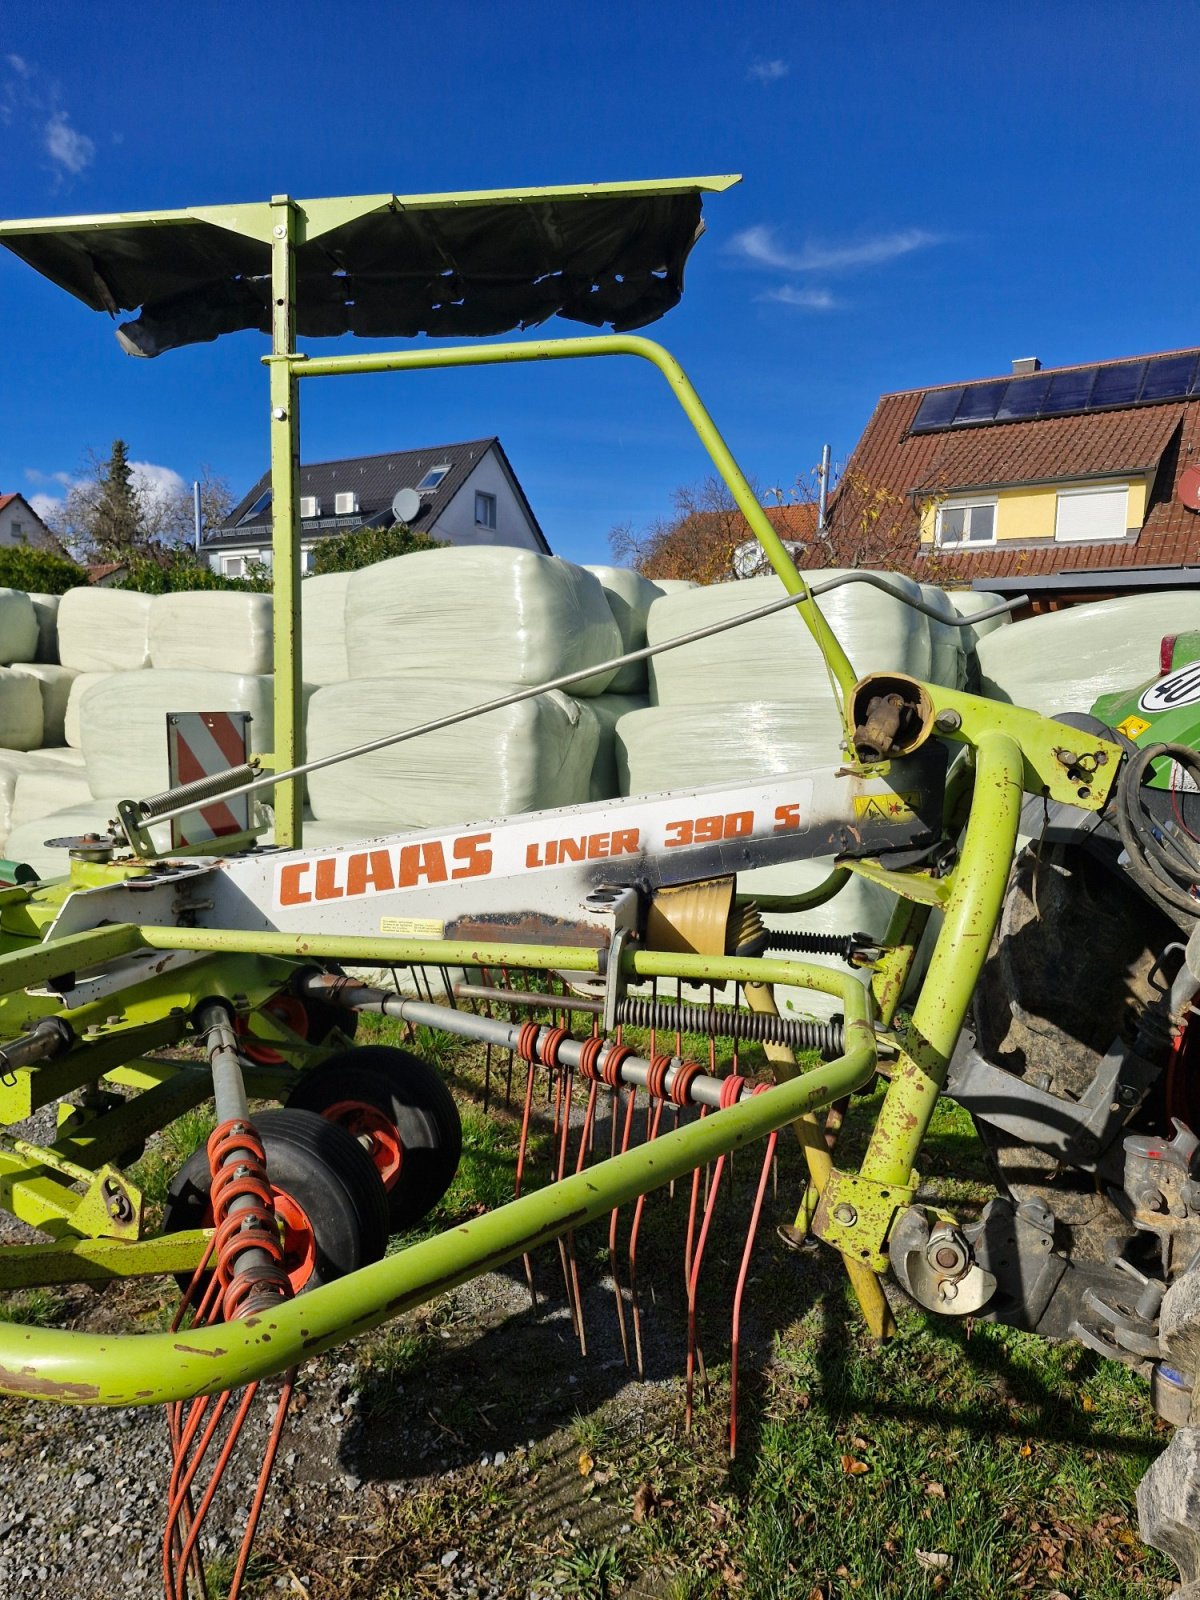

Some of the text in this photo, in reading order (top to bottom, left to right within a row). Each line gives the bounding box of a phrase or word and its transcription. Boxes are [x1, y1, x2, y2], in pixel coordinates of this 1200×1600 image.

[280, 804, 801, 906] CLAAS LINER 390 S
